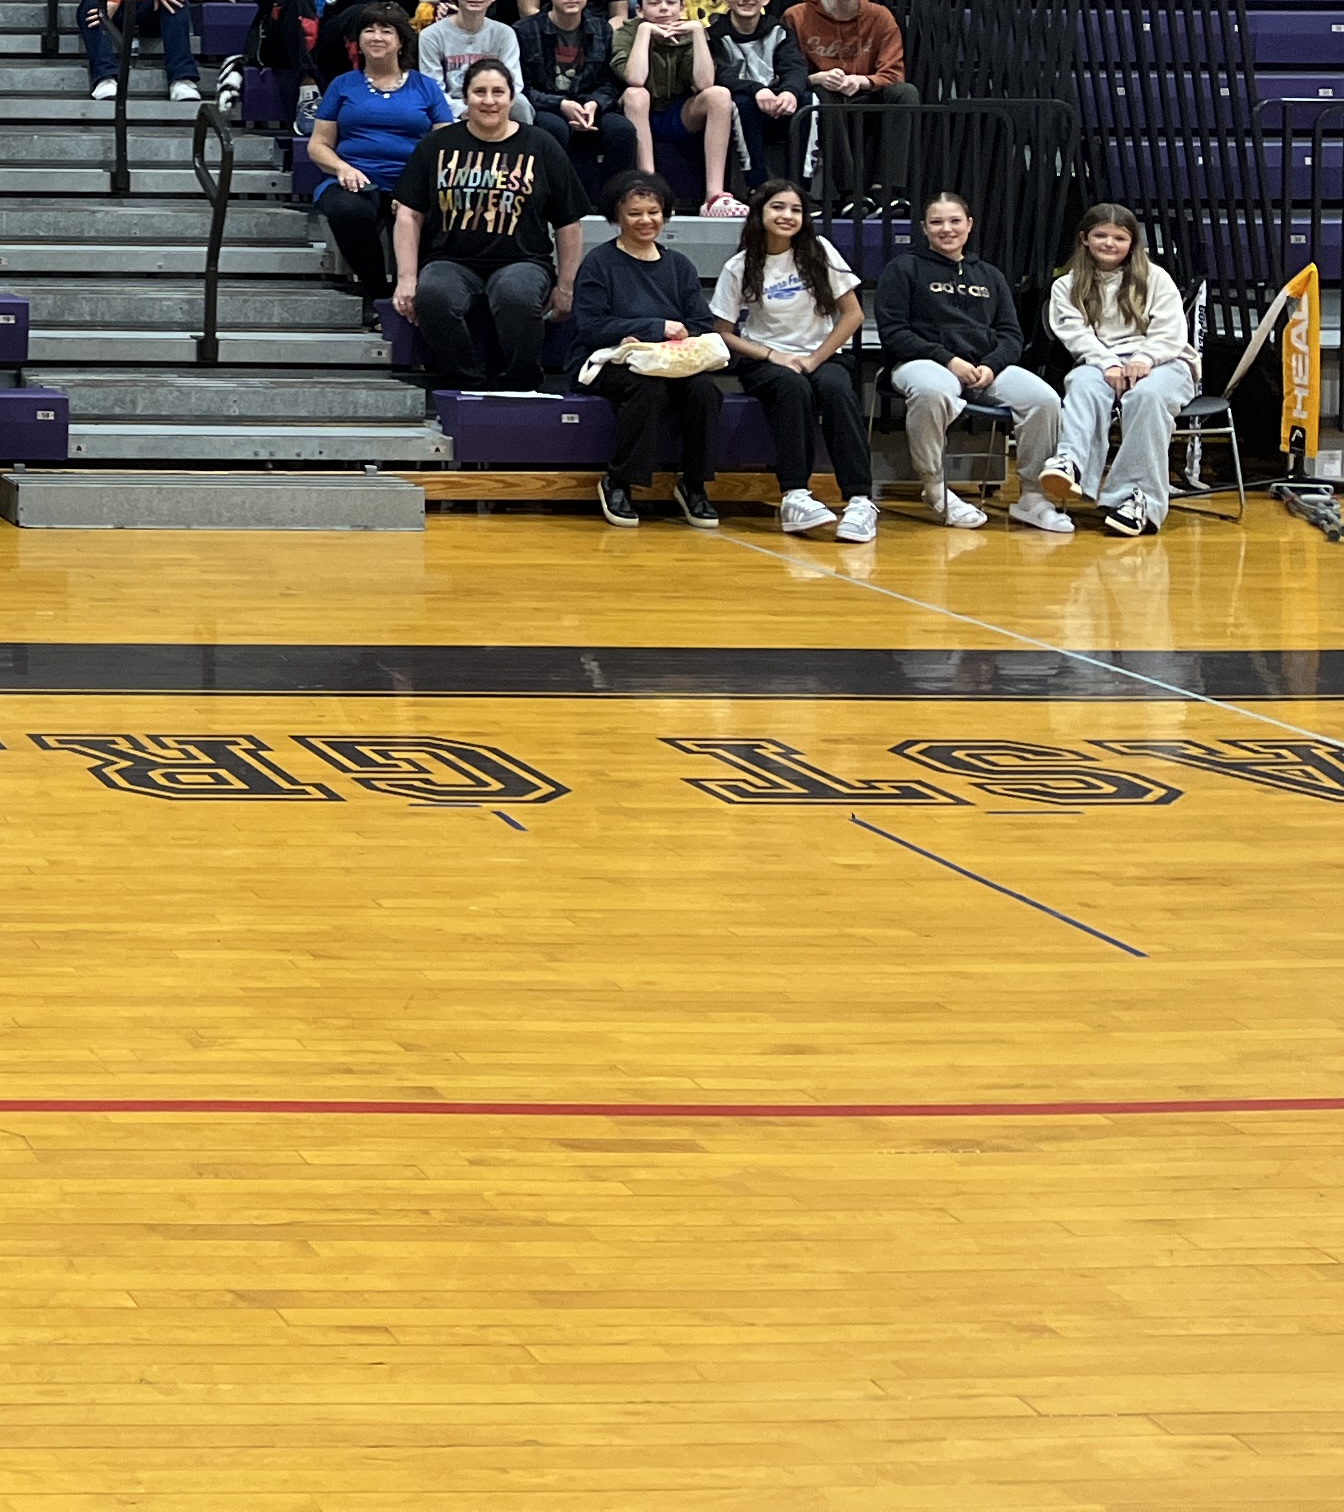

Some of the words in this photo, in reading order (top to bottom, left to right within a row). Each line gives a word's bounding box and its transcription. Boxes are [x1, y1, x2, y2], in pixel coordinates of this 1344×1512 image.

[437, 167, 533, 195] KINDNESS
[439, 188, 525, 217] MATTERS
[1290, 291, 1310, 420] HEA
